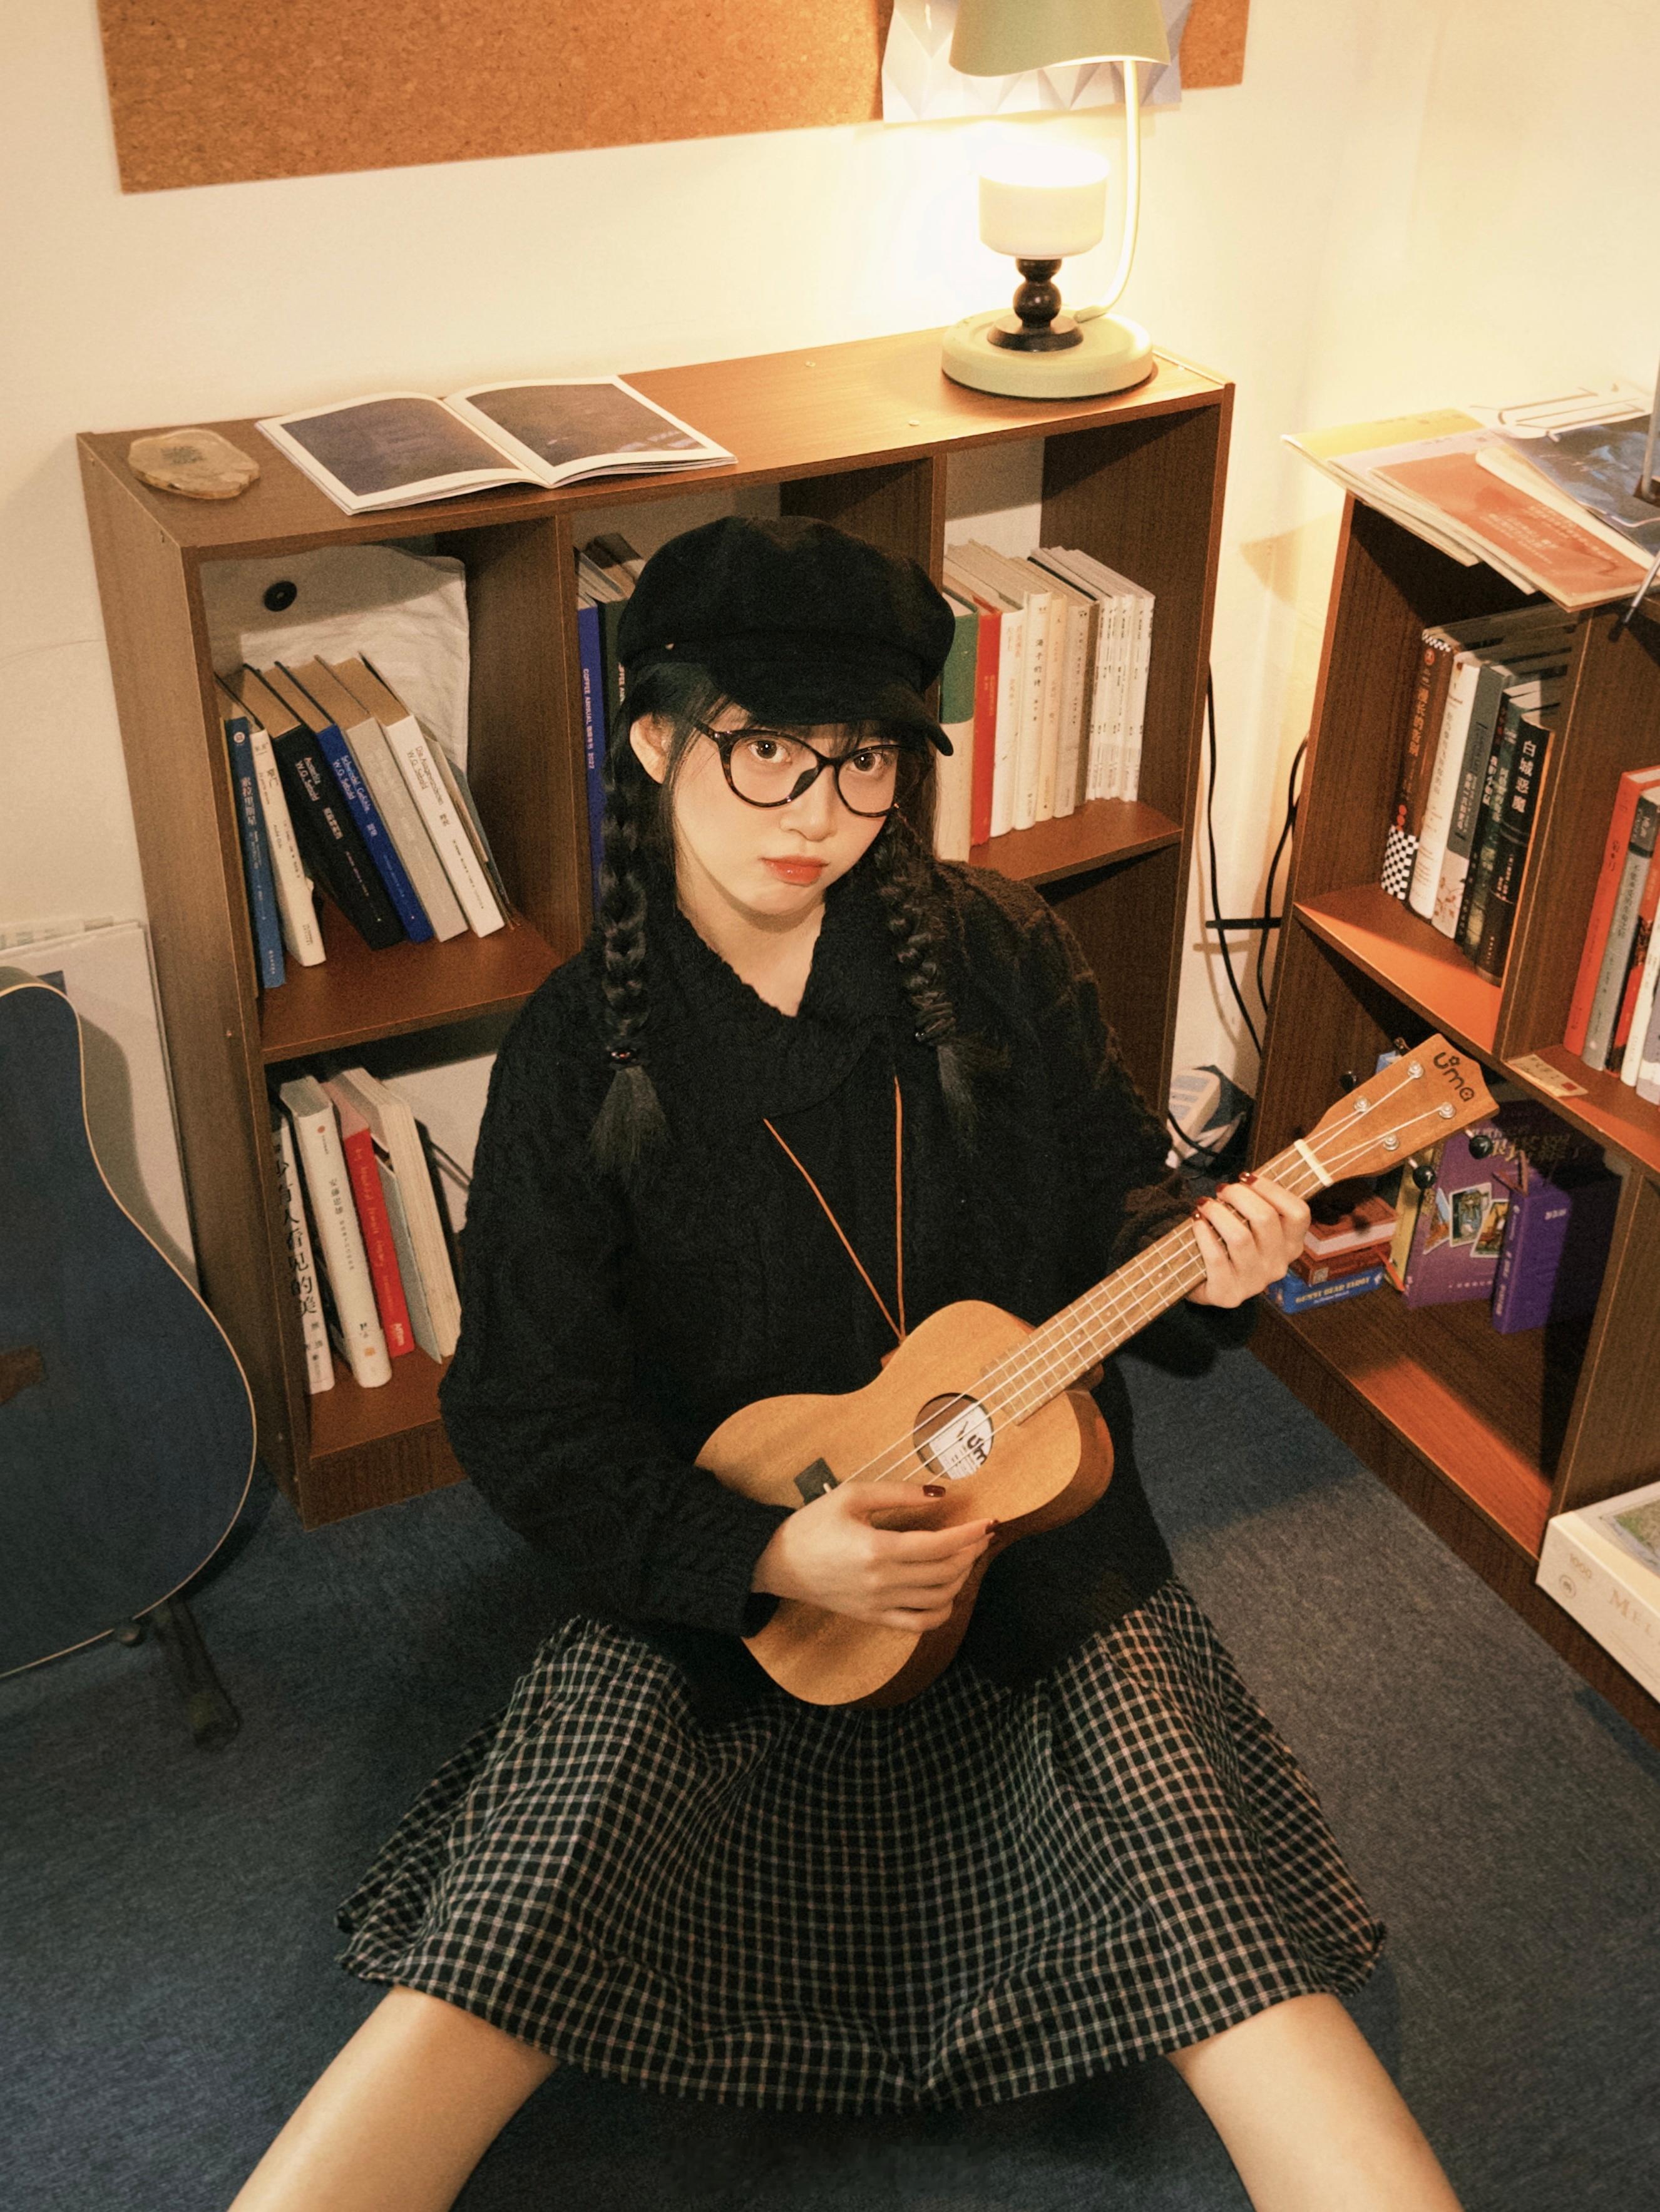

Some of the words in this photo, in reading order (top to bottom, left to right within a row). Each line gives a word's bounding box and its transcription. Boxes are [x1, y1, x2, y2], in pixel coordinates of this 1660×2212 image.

[1512, 740, 1537, 813] 白城恶魔
[273, 1145, 317, 1316] 少有人看见的美
[1609, 1587, 1660, 1646] MEL
